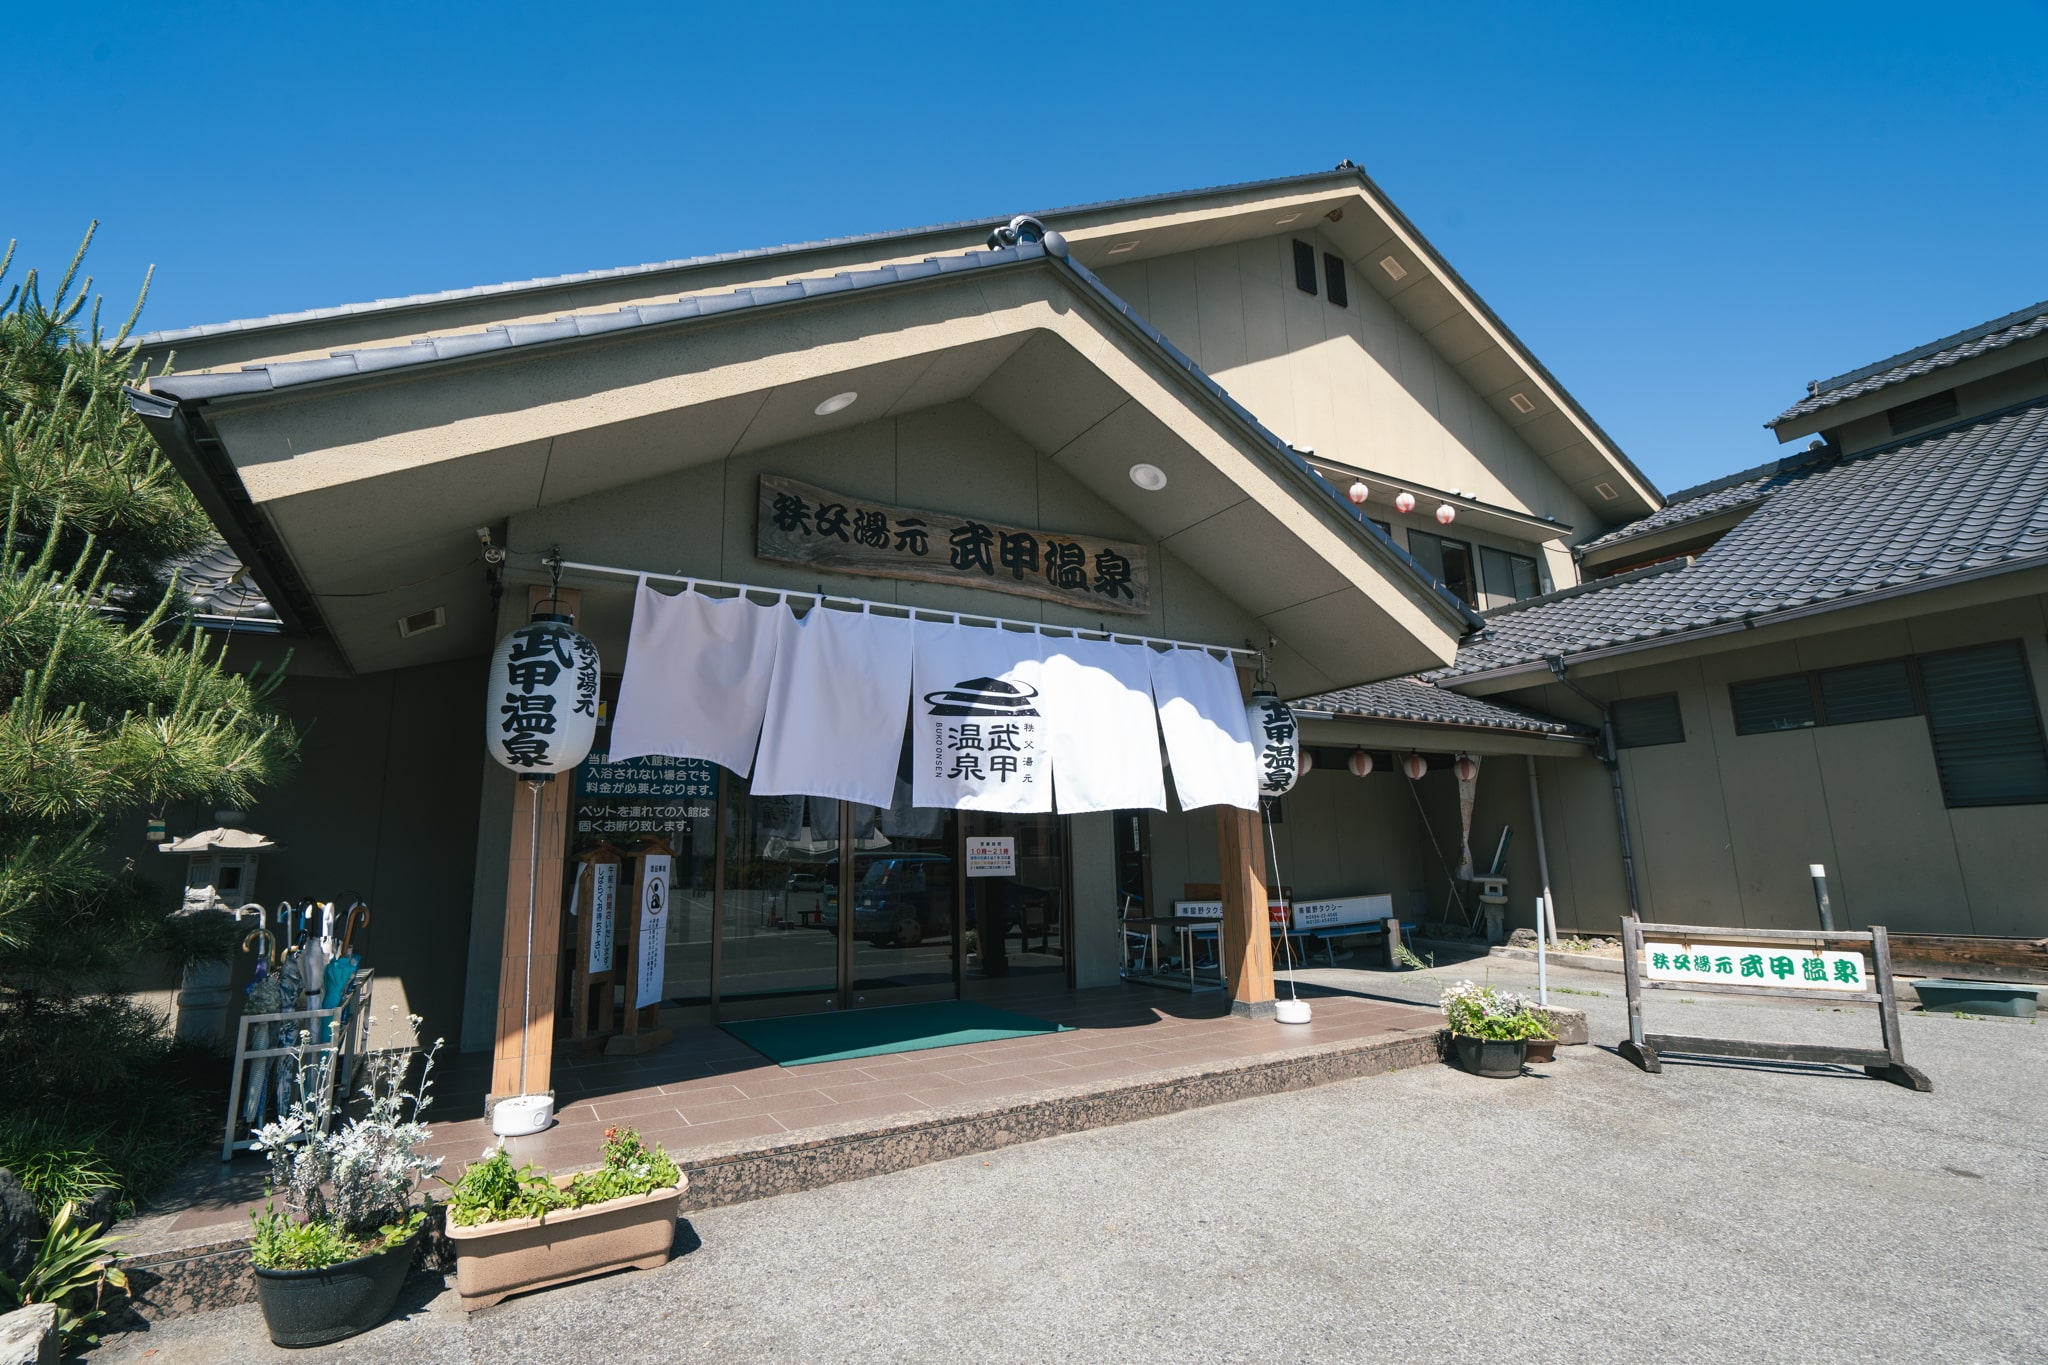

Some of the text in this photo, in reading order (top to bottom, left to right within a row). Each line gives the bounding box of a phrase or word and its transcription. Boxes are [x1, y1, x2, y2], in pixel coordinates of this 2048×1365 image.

[772, 492, 1135, 599] 秩父湯元 武甲温泉
[501, 626, 575, 767] 武甲温泉
[587, 767, 711, 781] 入浴されない場合でも
[935, 722, 943, 778] BUKO ONSEN
[1022, 723, 1035, 783] 秩父湯元
[1261, 701, 1297, 792] 武甲温泉
[579, 806, 711, 818] ペットを連れての入館は
[585, 782, 714, 796] 料金が必要となります。
[578, 820, 692, 832] 固くお断り致します。
[593, 866, 605, 962] しばらくお待ち下さい。
